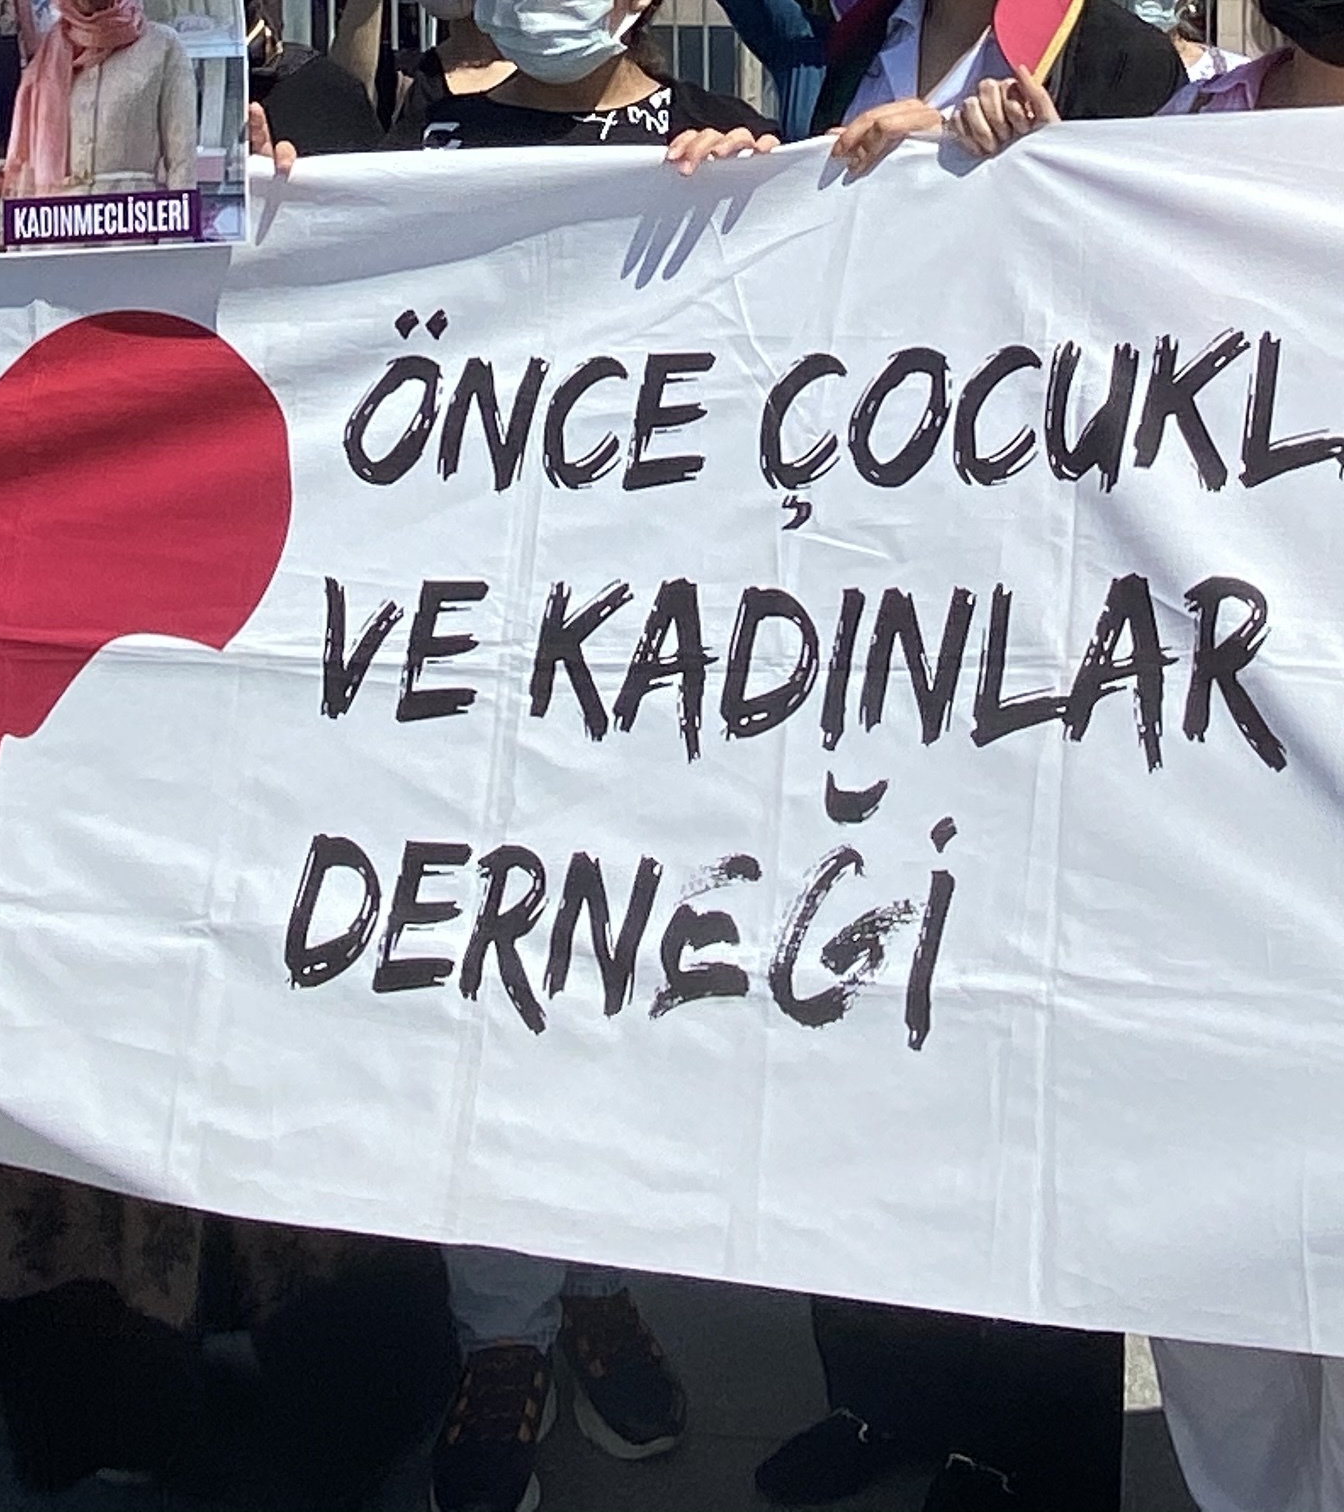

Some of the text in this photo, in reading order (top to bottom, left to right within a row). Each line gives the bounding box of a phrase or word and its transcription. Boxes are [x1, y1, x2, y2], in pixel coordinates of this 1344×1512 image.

[342, 309, 716, 492] ÖNCE
[322, 574, 1288, 773] VE KADINLAR
[285, 770, 956, 1051] DERNEĞİ
